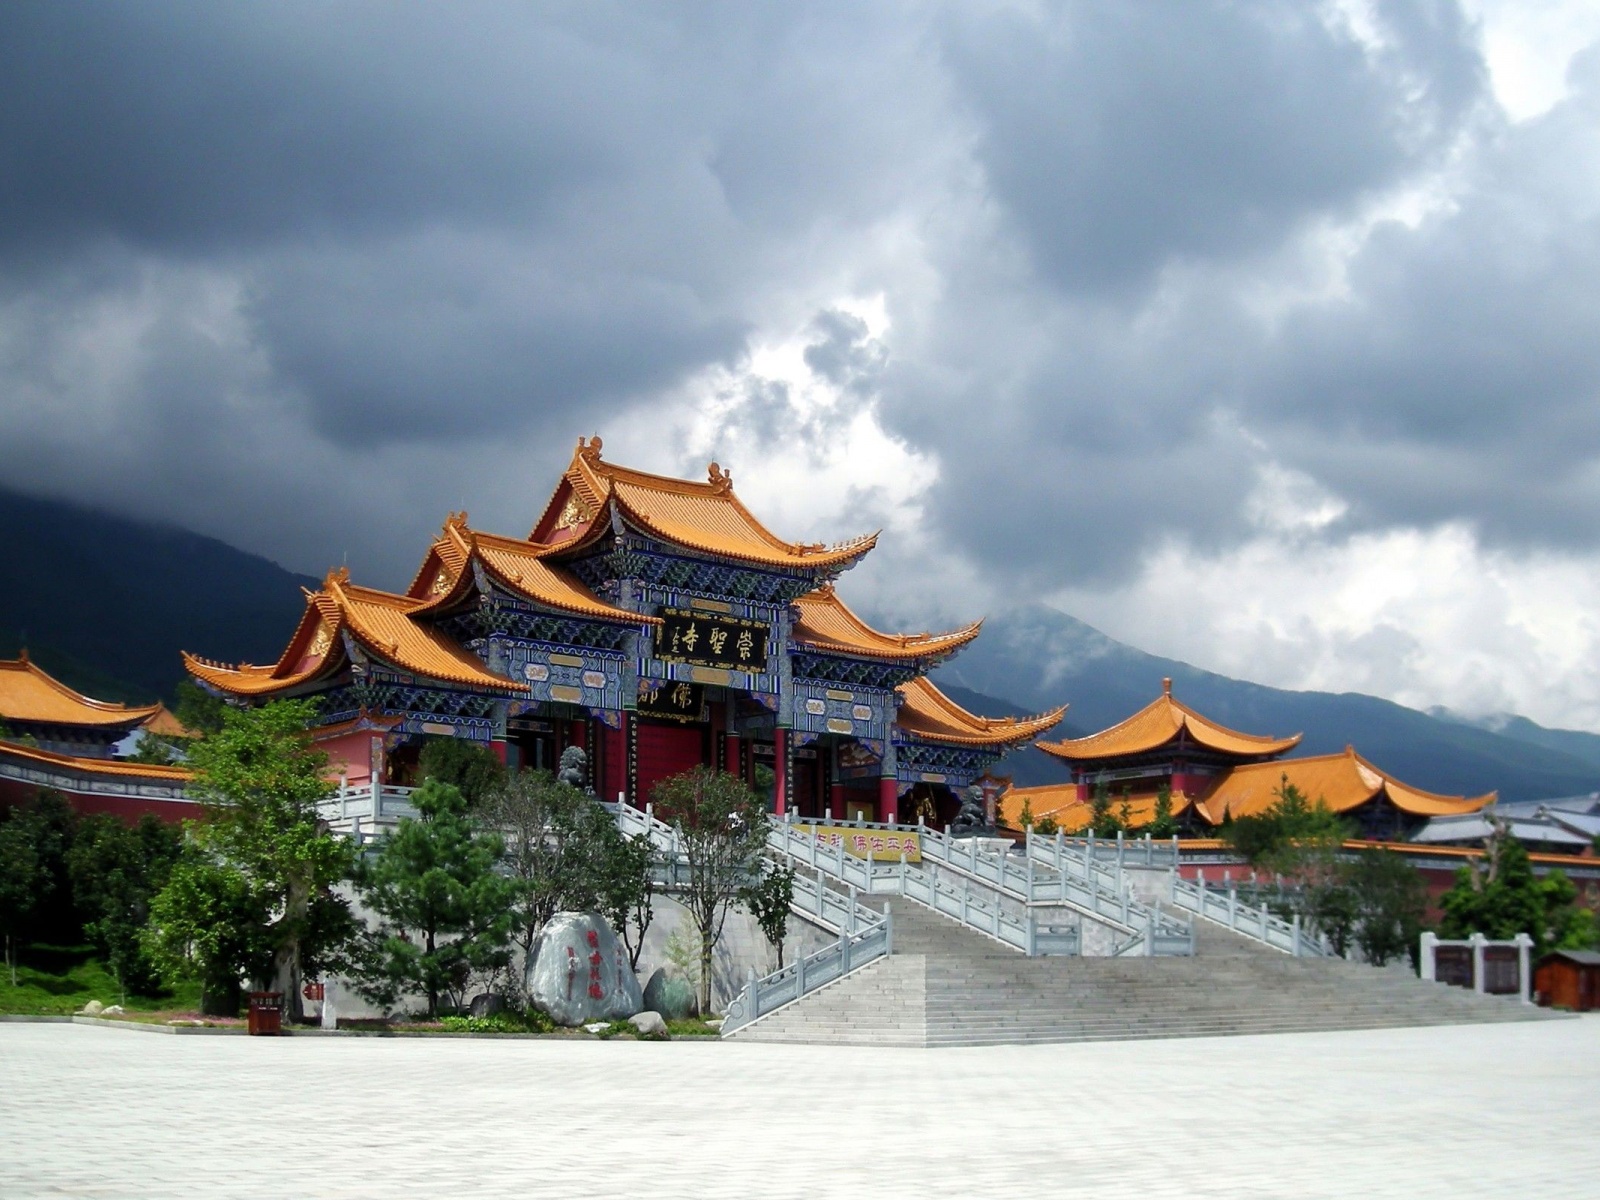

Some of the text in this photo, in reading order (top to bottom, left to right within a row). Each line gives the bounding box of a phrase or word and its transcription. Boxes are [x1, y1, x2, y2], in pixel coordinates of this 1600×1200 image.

[681, 622, 754, 660] 崇聖寺
[852, 834, 917, 855] 佛佑平安
